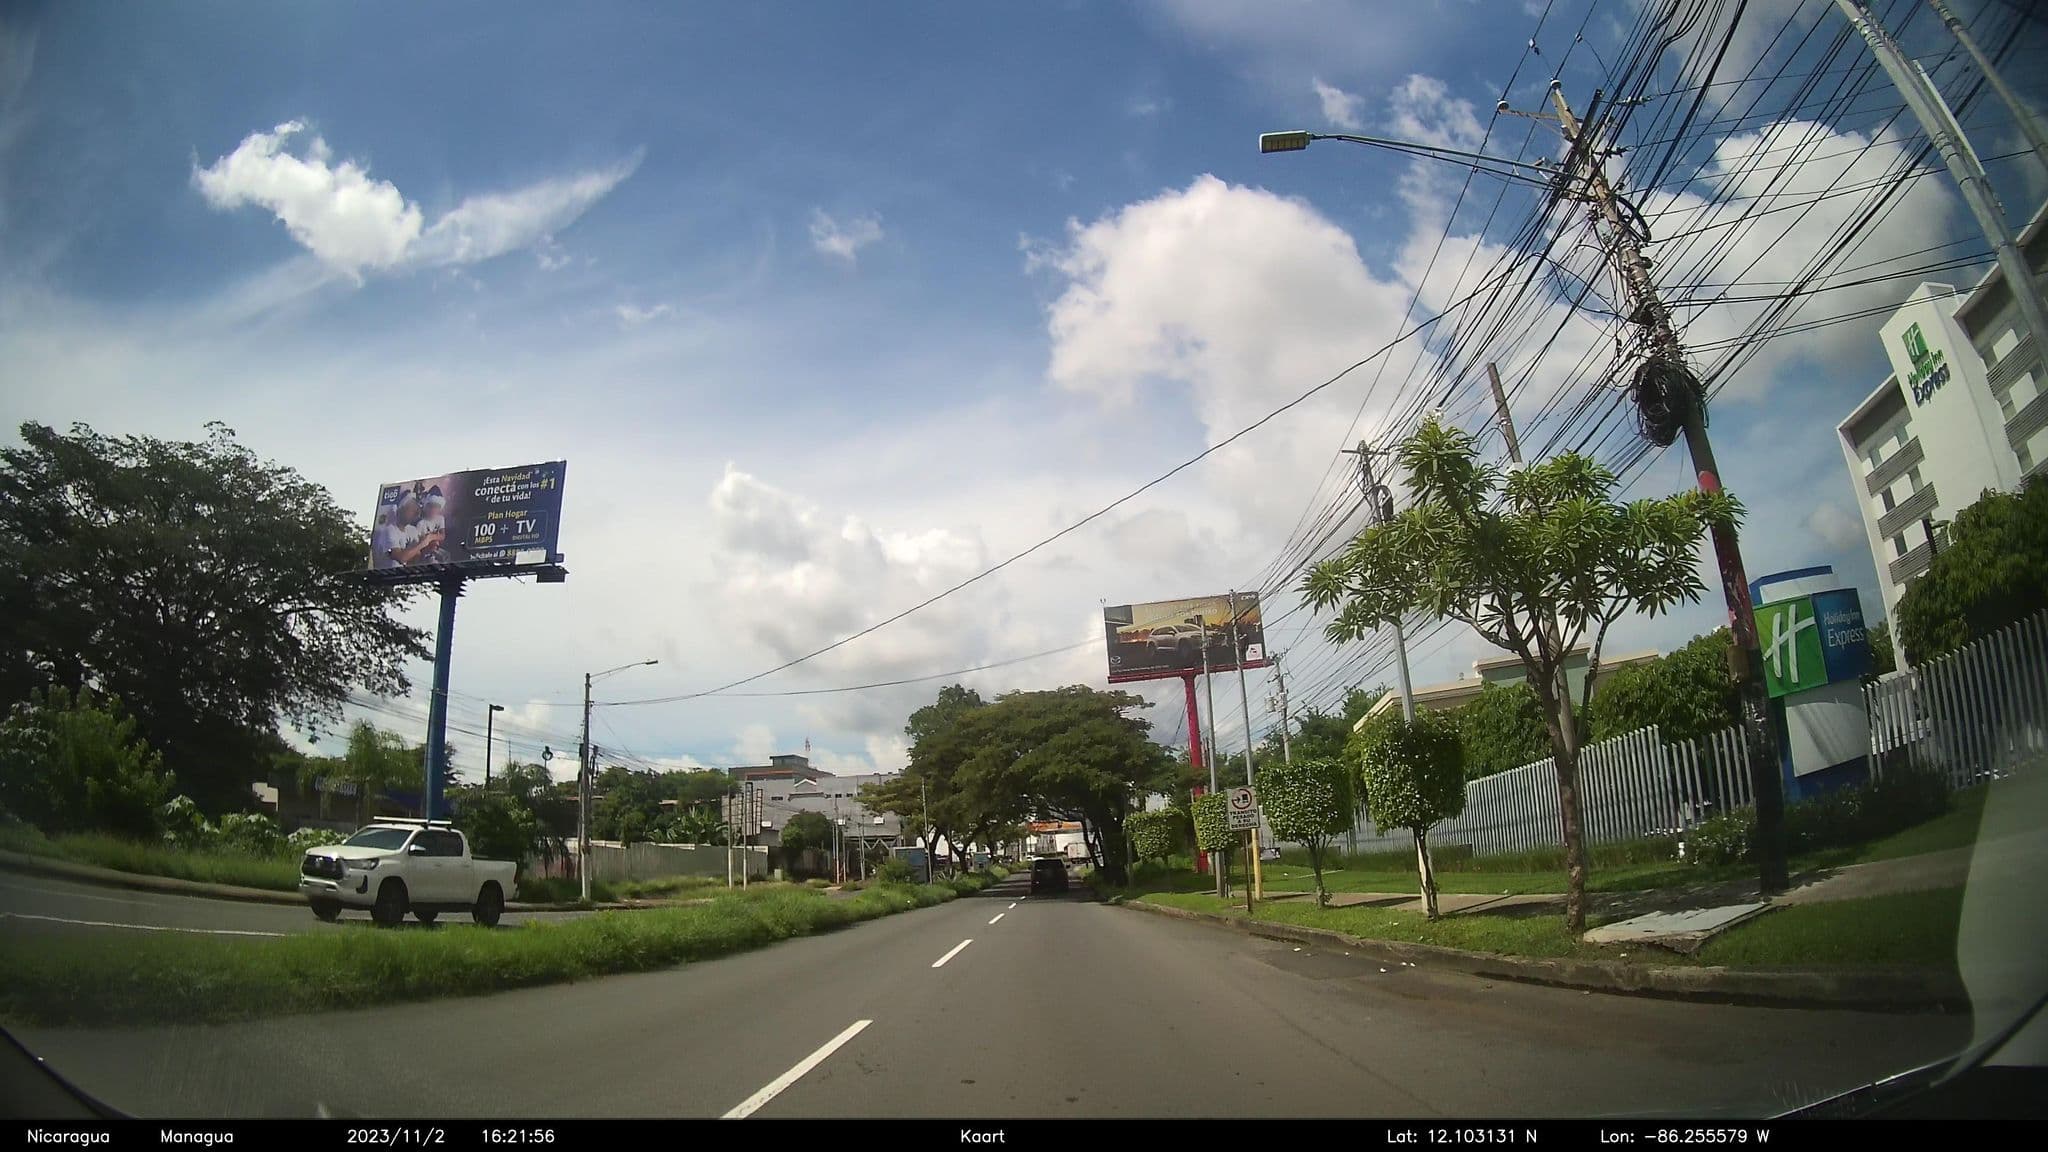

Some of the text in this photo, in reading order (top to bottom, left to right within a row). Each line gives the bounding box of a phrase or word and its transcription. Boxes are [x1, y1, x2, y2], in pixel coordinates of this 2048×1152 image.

[501, 471, 532, 482] Navidad
[474, 481, 516, 496] conectá
[517, 483, 529, 491] con
[491, 494, 501, 503] de
[512, 491, 532, 501] vida!
[487, 509, 528, 520] Plan Hogar
[474, 522, 496, 537] 100
[516, 519, 537, 534] TV
[1827, 626, 1865, 650] Express
